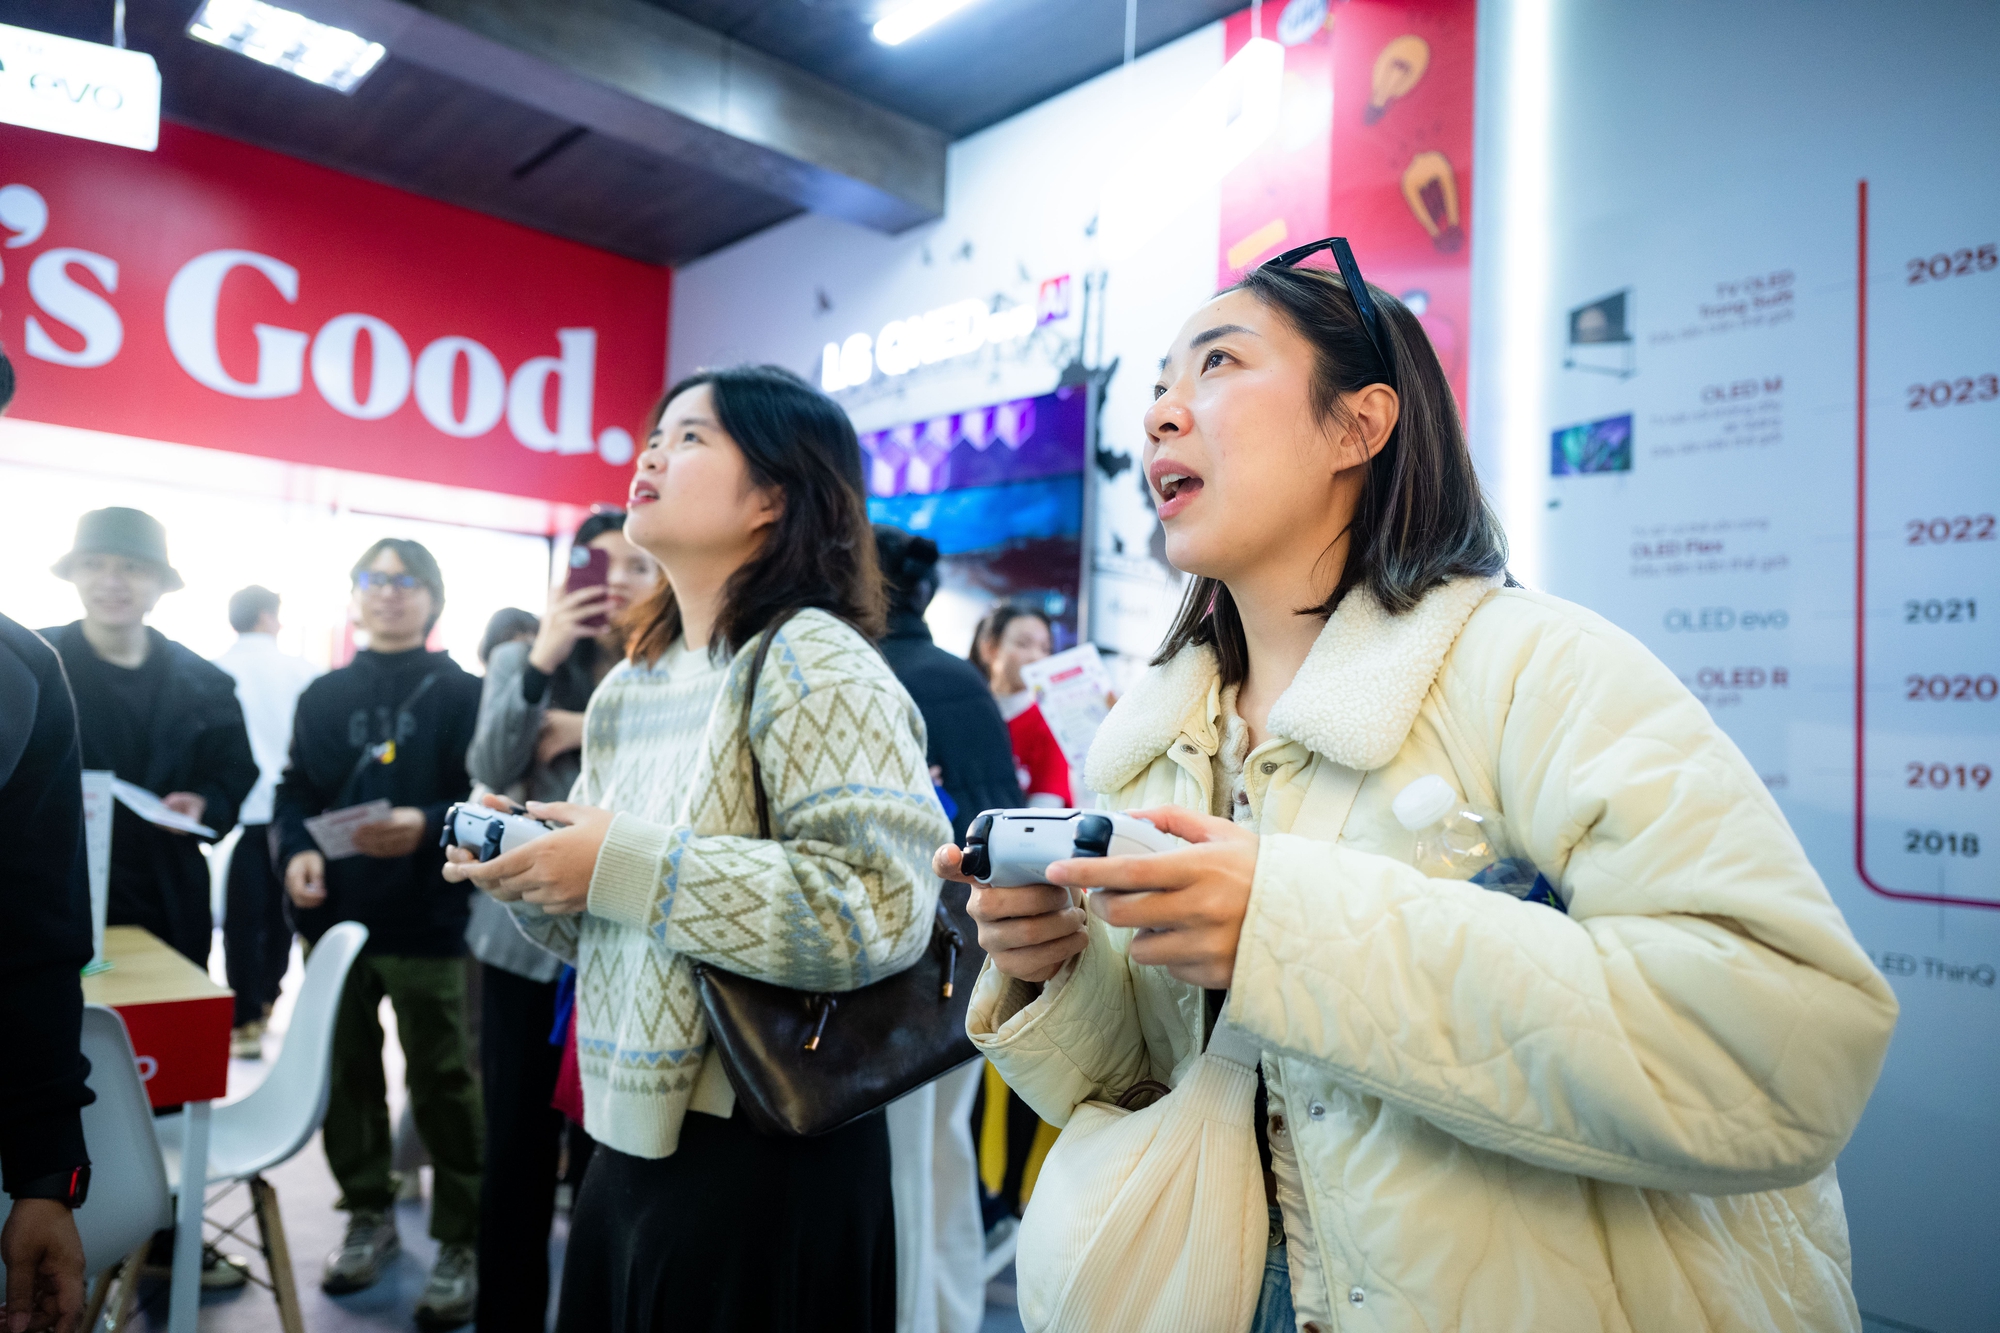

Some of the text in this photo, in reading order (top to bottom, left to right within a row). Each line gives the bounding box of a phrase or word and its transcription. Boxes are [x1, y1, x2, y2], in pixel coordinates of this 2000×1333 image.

[1906, 243, 1999, 285] 2025
[164, 249, 634, 466] Good.
[1700, 377, 1760, 405] OLED
[1906, 374, 1999, 411] 2023
[1905, 513, 1997, 546] 2022
[1662, 605, 1790, 634] OLED evo
[1904, 597, 1977, 625] 2021
[1696, 666, 1767, 690] OLED
[1905, 674, 1999, 702] 2020
[1906, 761, 1993, 792] 2019
[1904, 828, 1980, 859] 2018
[1923, 955, 1997, 989] ThinQ
